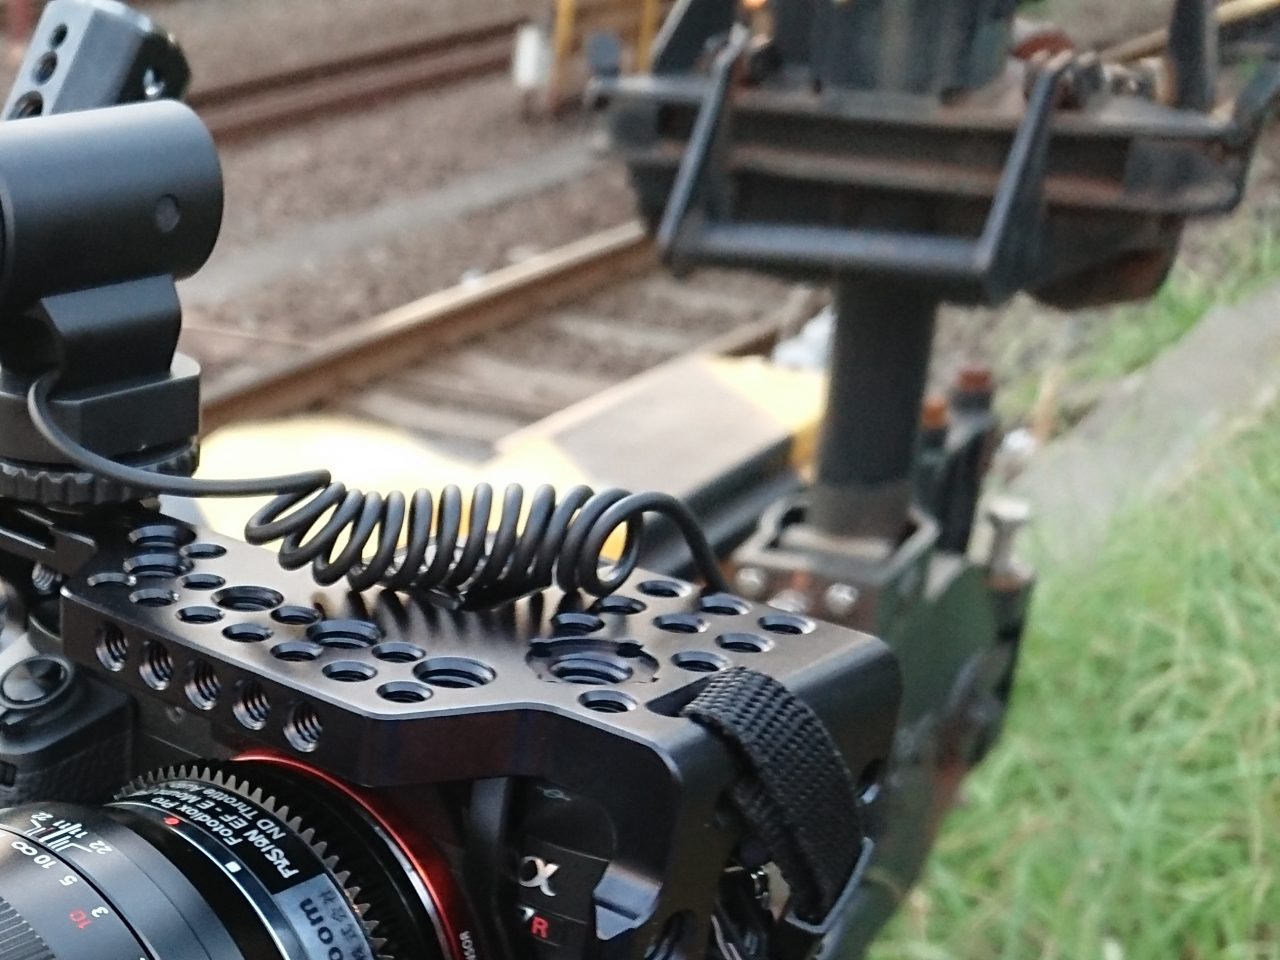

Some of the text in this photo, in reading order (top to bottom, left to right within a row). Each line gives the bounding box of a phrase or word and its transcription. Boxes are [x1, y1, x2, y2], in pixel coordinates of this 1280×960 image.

[195, 799, 217, 811] E
[150, 796, 244, 847] Fotodiox Pro
[218, 813, 250, 831] EF
[255, 817, 288, 841] ND
[88, 839, 114, 856] 22
[33, 854, 58, 870] 10
[58, 874, 79, 888] 5
[69, 908, 94, 930] 10
[90, 905, 110, 919] 3
